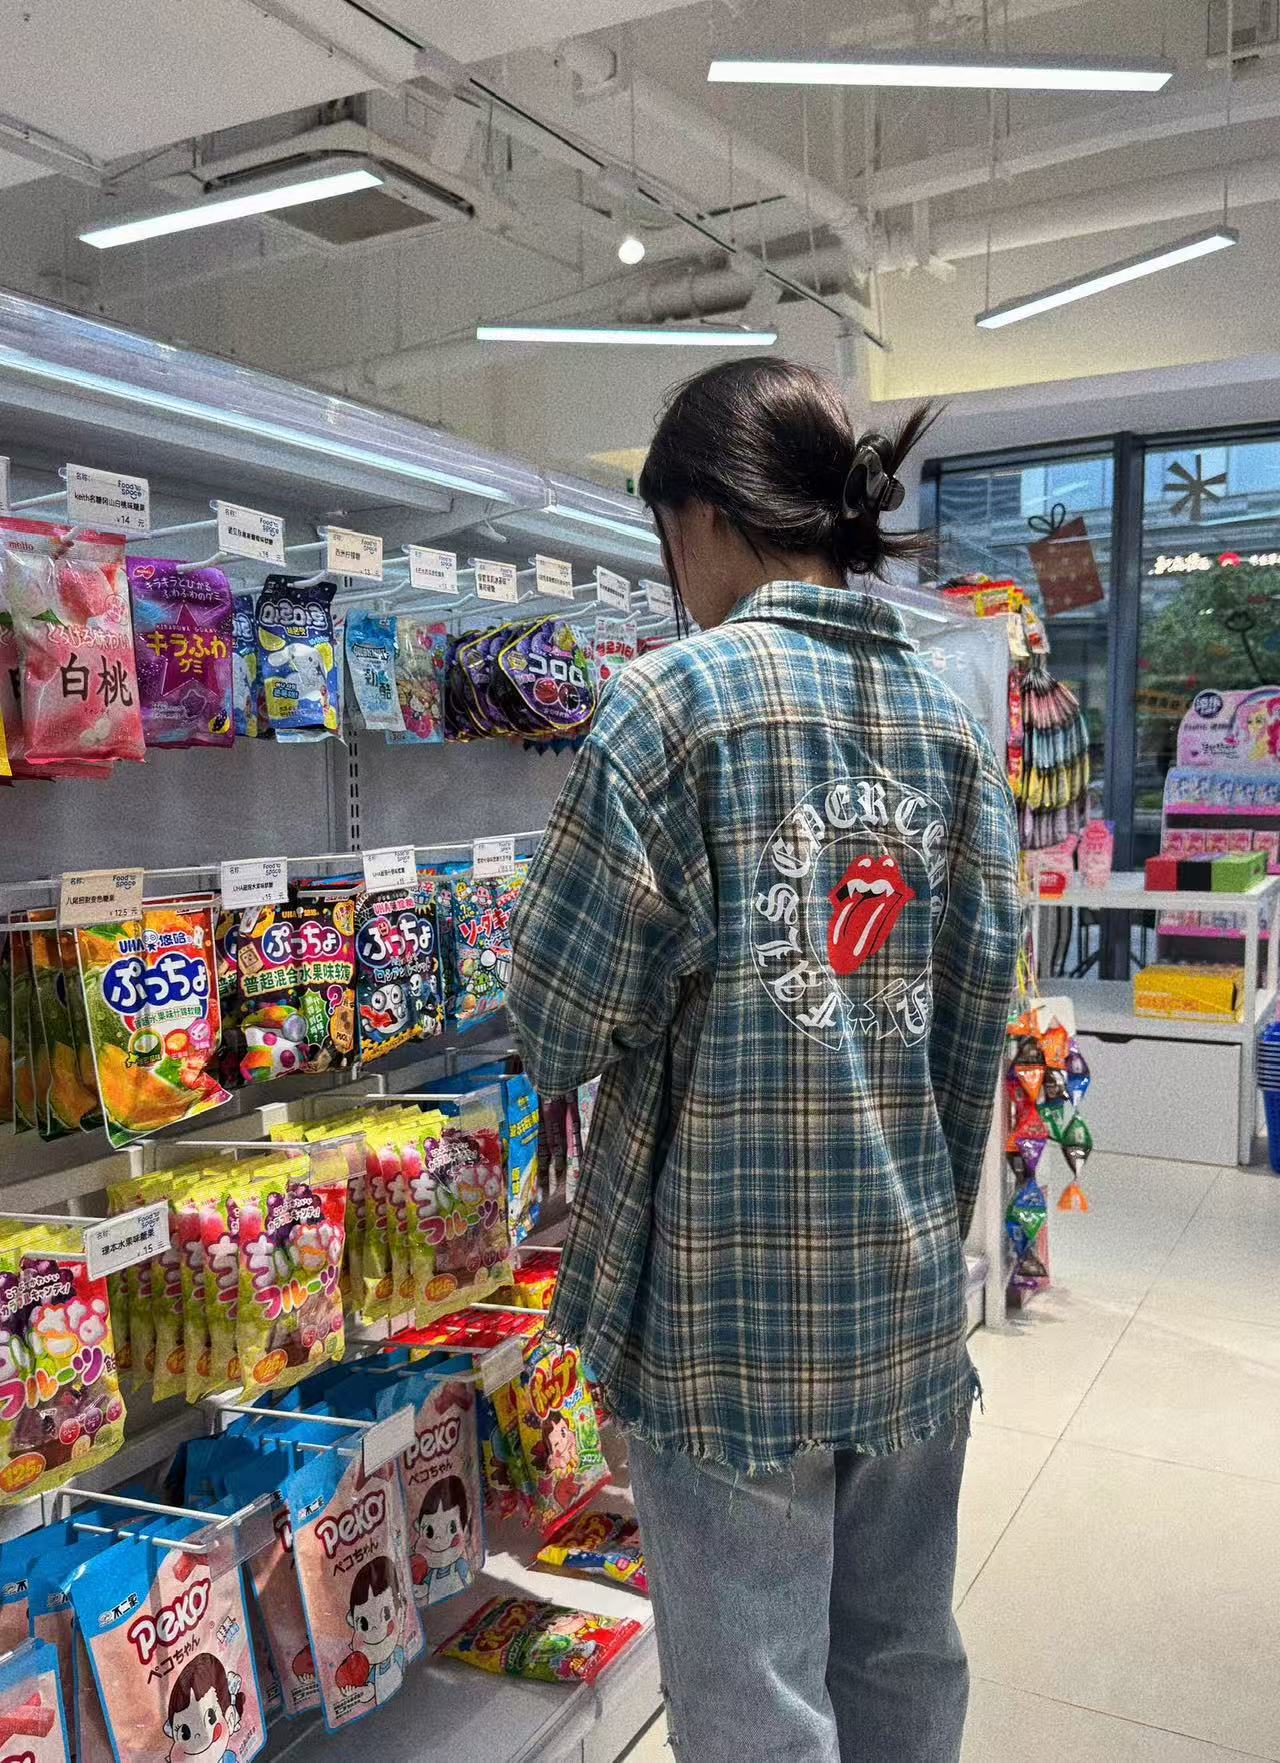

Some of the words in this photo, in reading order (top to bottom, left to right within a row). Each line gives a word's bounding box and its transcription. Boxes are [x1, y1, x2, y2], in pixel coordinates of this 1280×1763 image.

[145, 630, 228, 659] キラふわ
[59, 651, 134, 708] 白桃
[178, 657, 203, 674] グミ
[265, 923, 338, 959] ぷっちょ
[458, 907, 512, 947] ソーダキ
[119, 938, 145, 954] UHA
[109, 956, 209, 1008] ぷっちょ
[407, 1456, 454, 1487] ペコちゃん
[332, 1537, 380, 1577] ペコちゃん
[111, 1591, 139, 1620] 不二家
[146, 1633, 201, 1686] ペコちゃん
